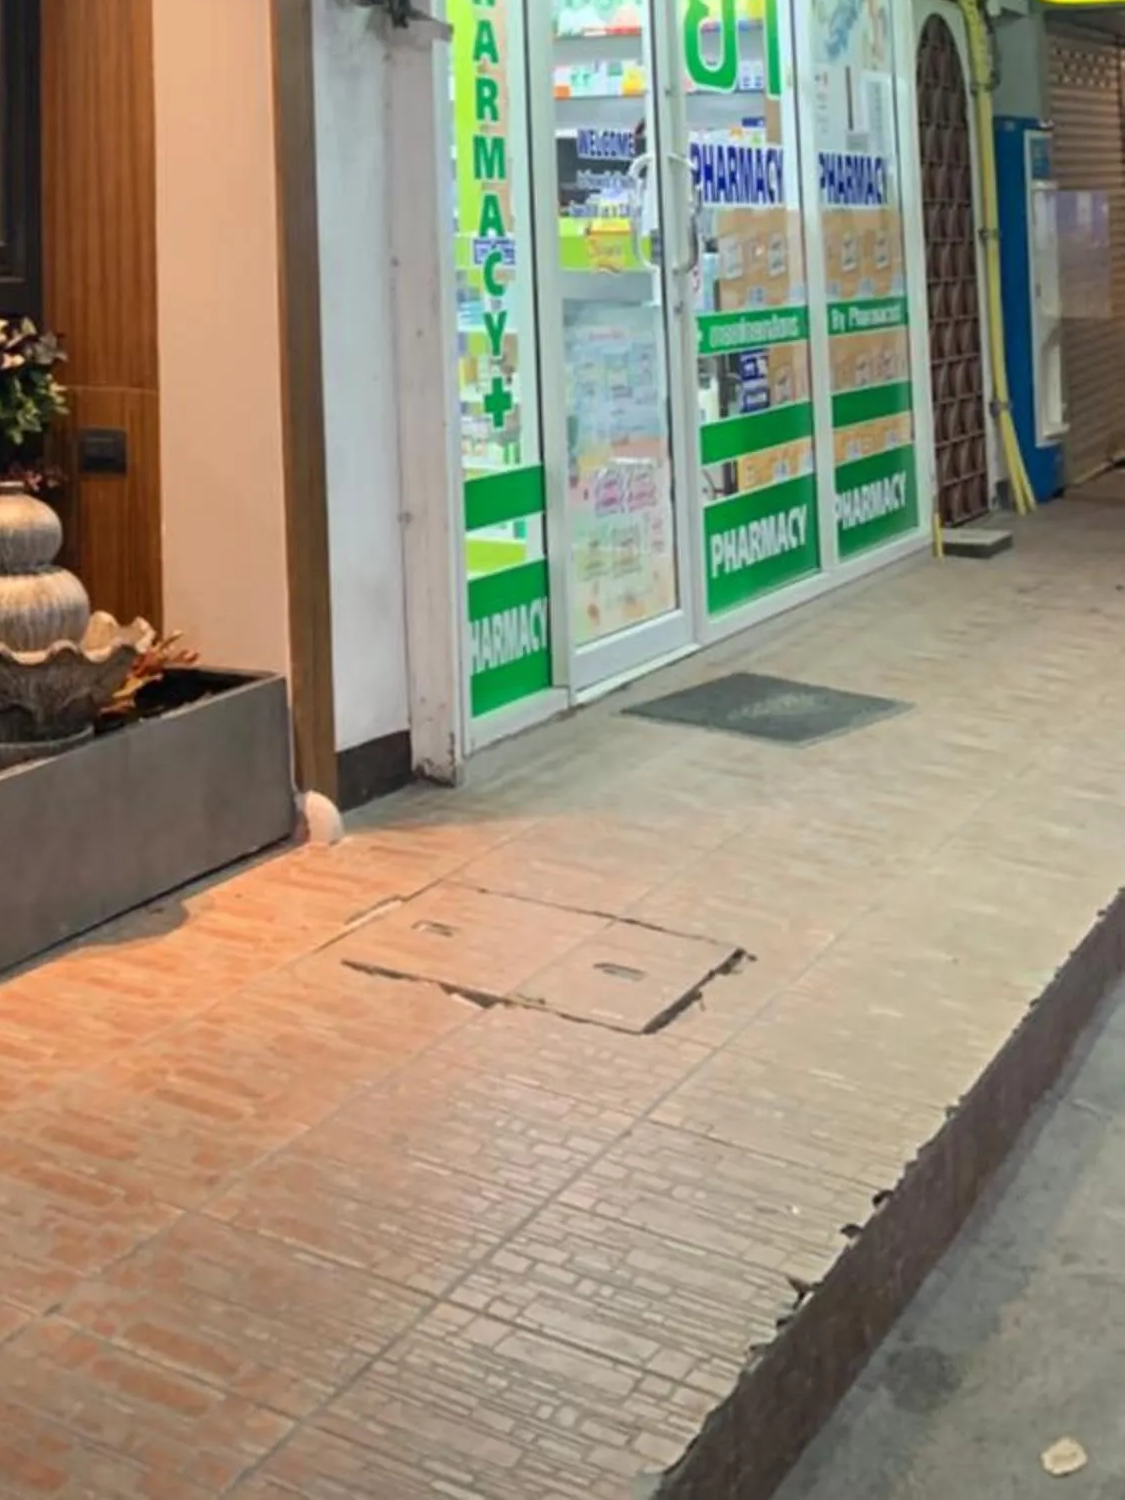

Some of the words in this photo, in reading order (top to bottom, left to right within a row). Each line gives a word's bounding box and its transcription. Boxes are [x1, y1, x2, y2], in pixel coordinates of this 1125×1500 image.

[690, 143, 784, 204] PHARMACY
[709, 504, 807, 579] PHARMACY
[469, 596, 548, 674] HARMACY
